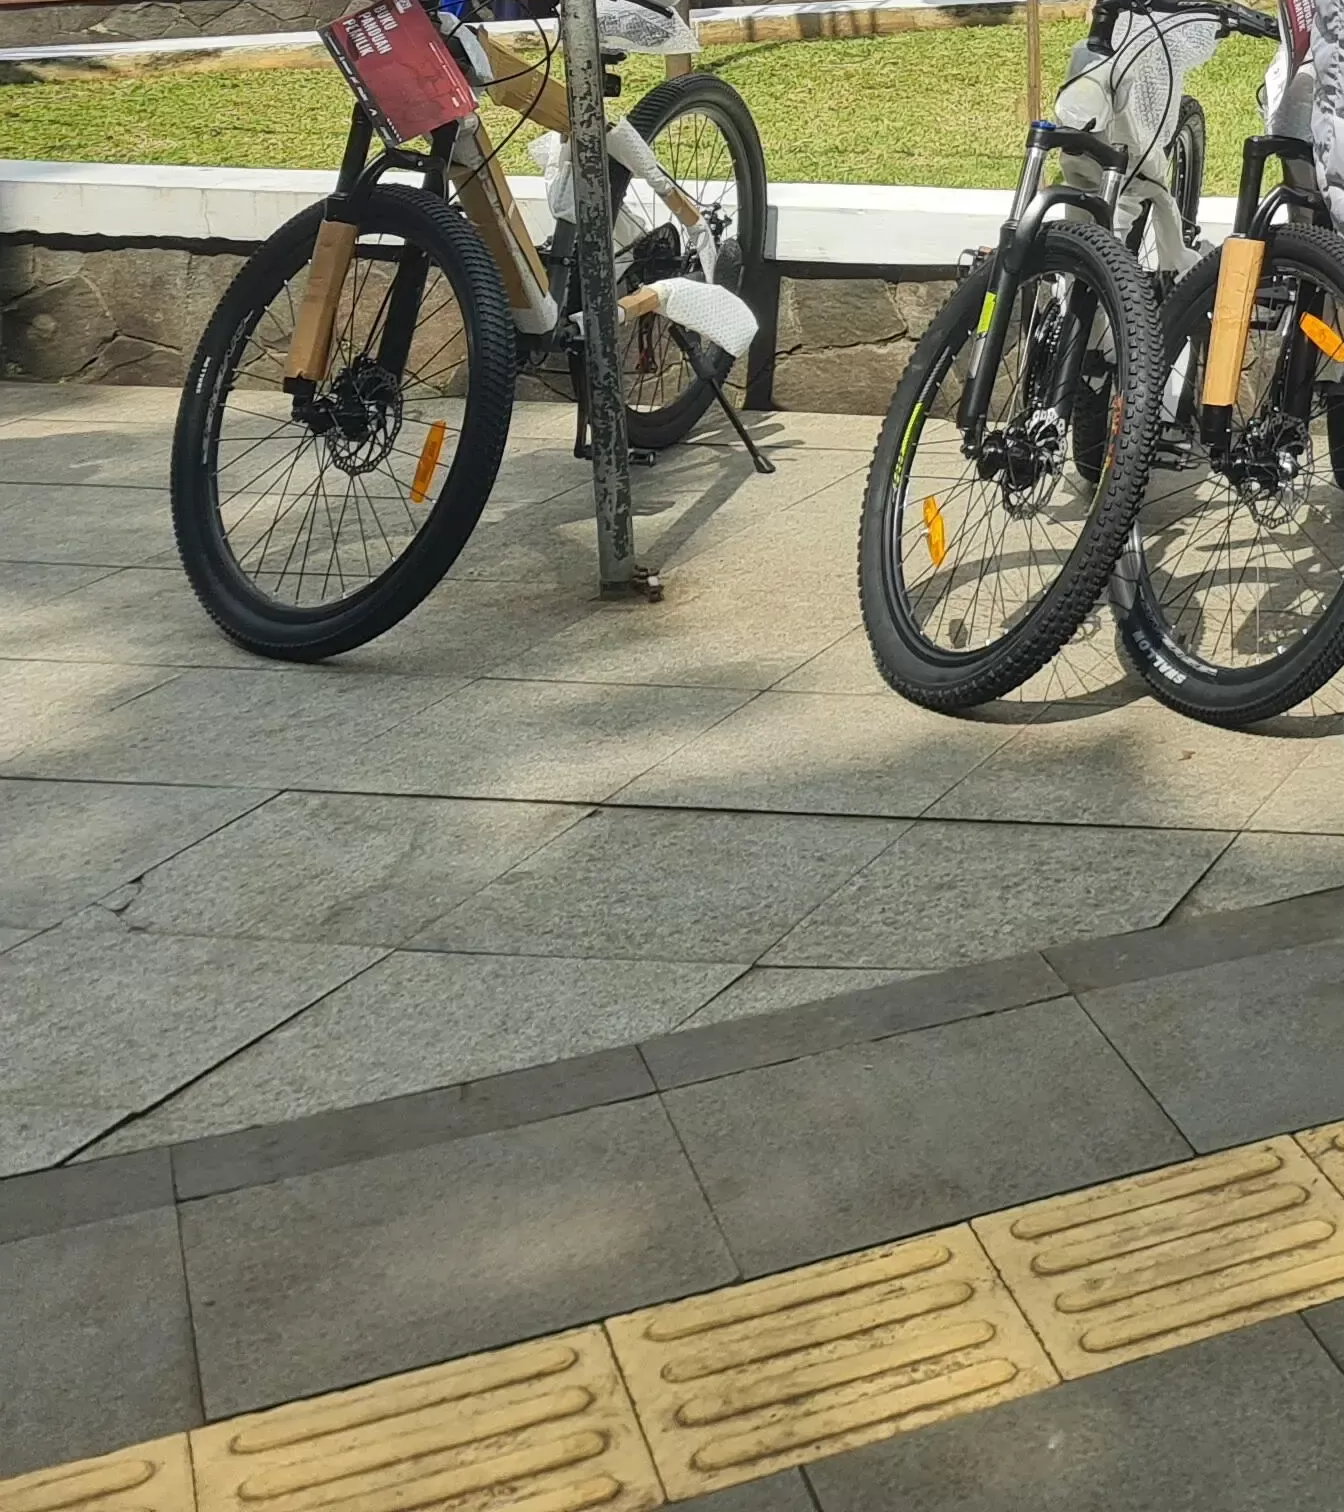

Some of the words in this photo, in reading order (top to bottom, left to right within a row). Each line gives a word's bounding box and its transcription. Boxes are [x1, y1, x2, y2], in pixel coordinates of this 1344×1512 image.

[359, 11, 393, 55] PANDUAN
[374, 3, 399, 31] BUKU
[342, 18, 375, 57] PEMILIK
